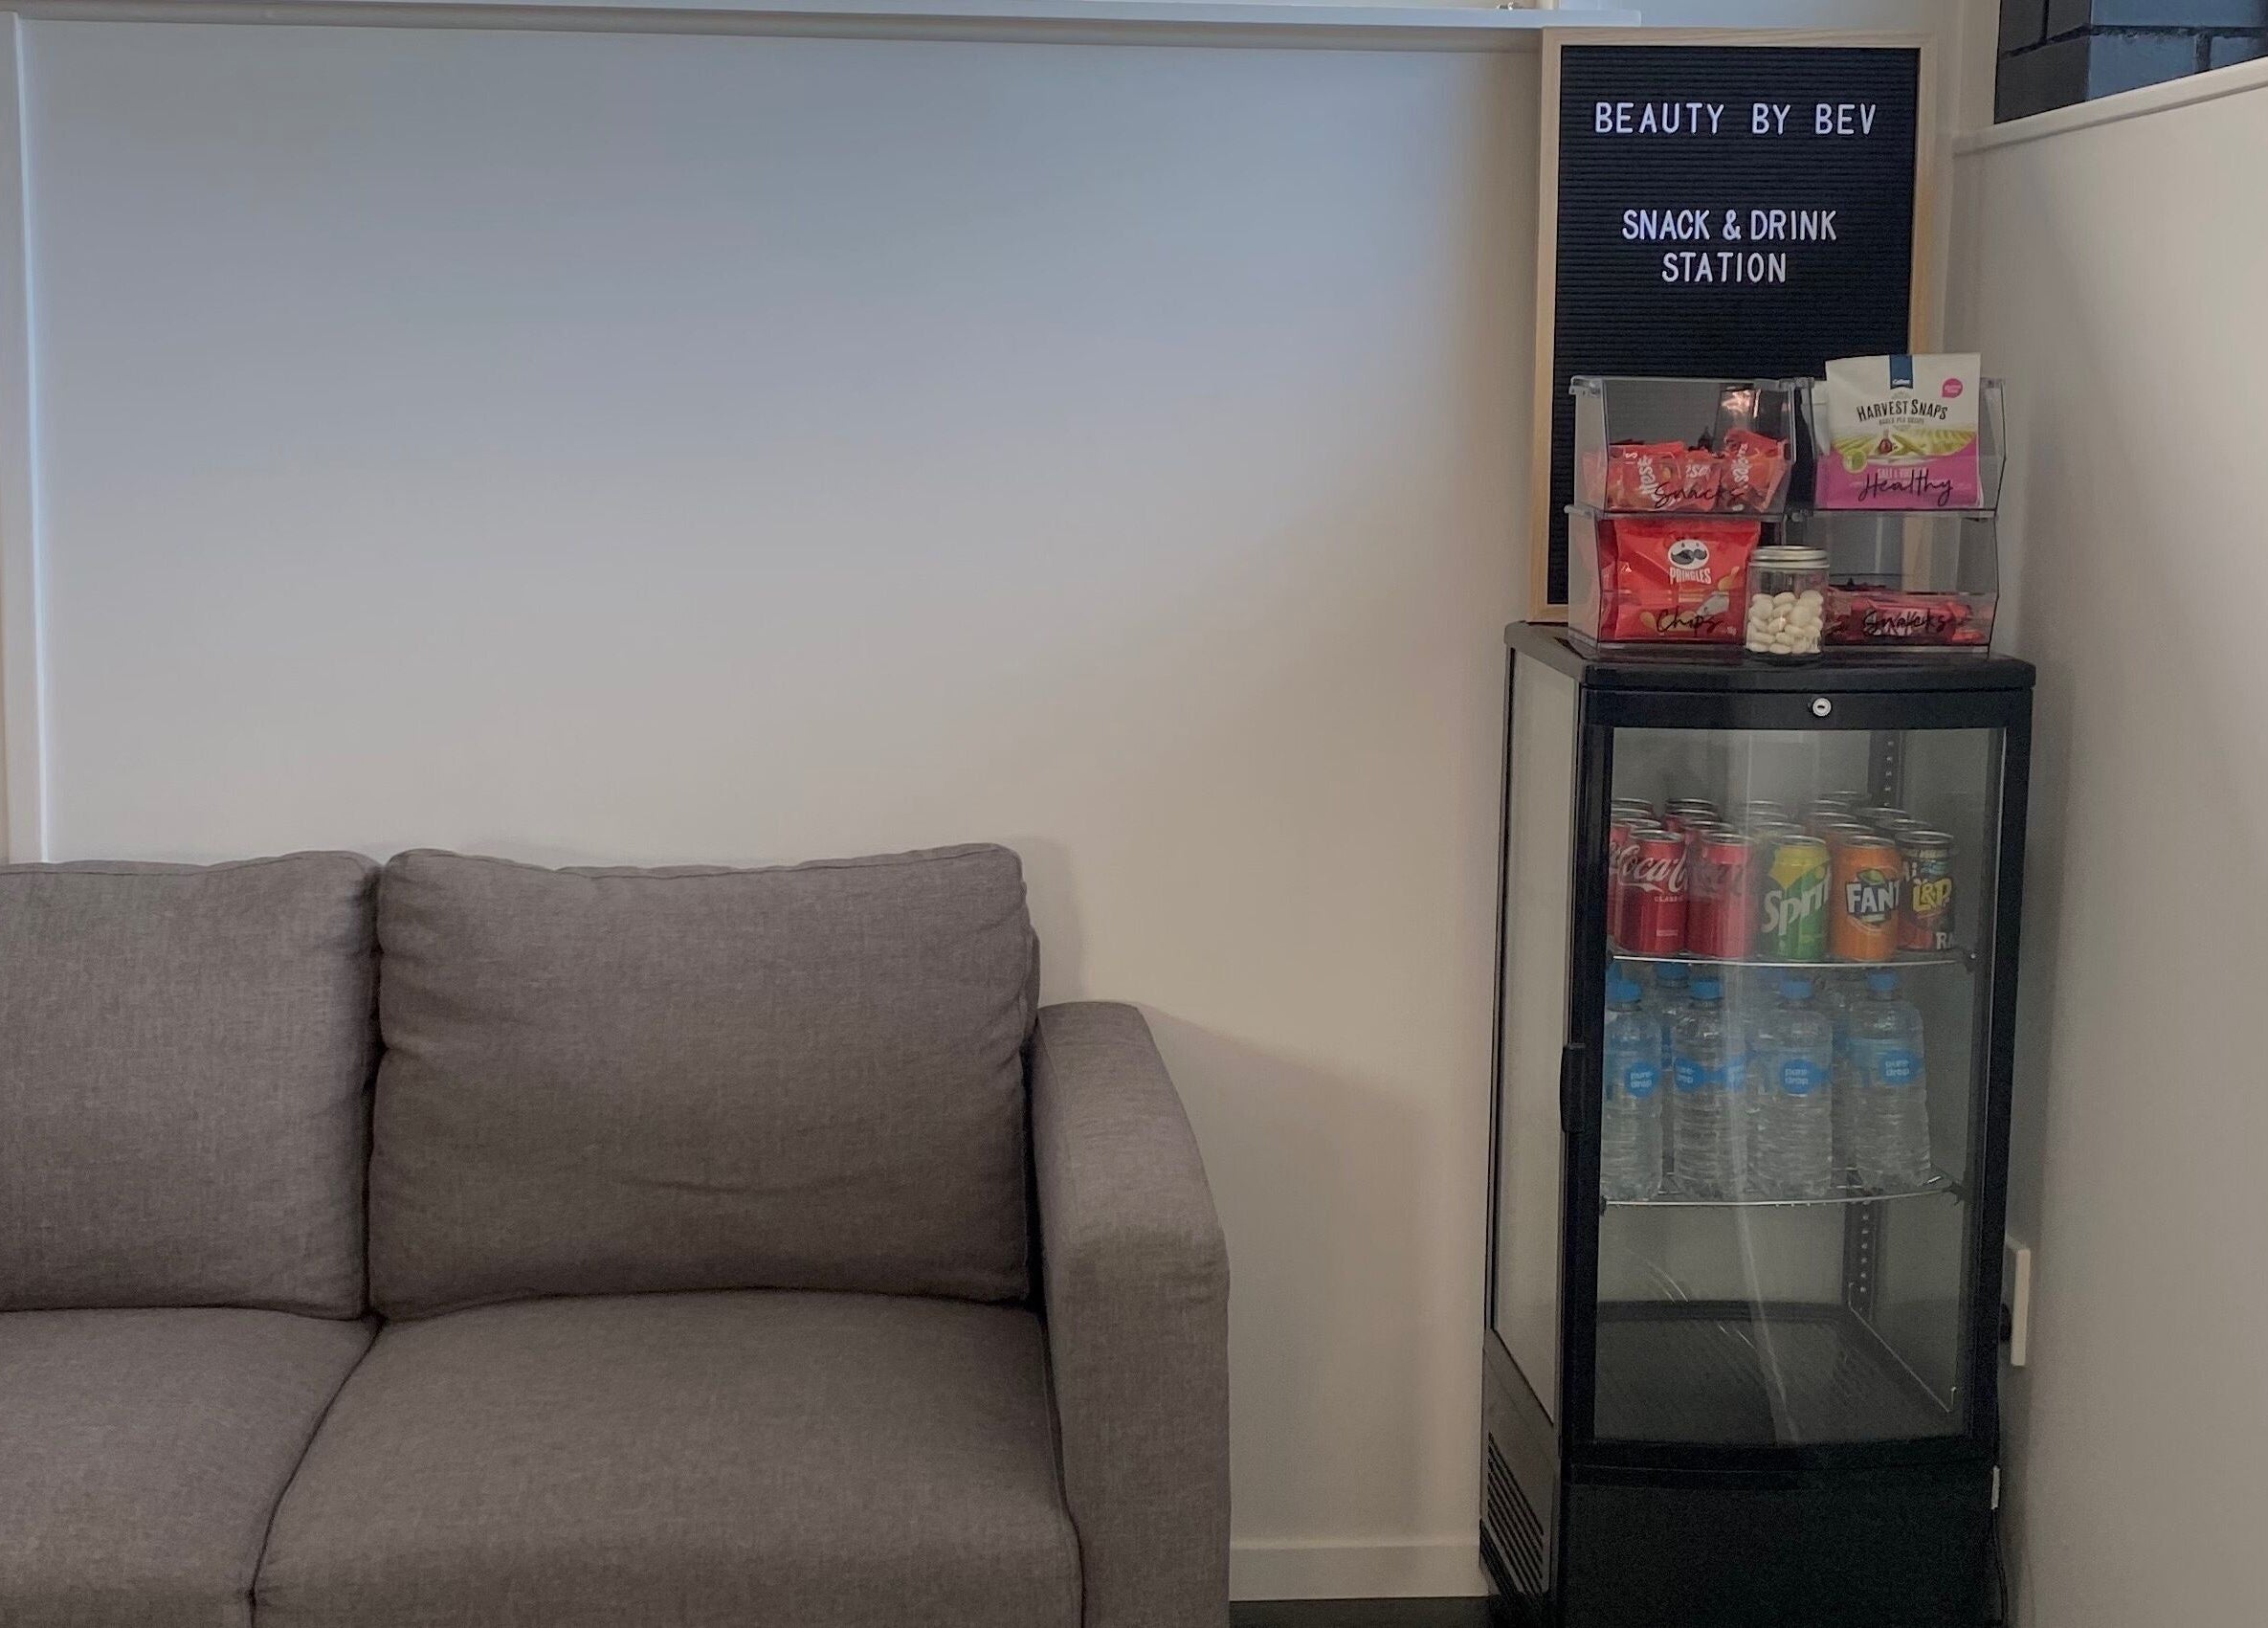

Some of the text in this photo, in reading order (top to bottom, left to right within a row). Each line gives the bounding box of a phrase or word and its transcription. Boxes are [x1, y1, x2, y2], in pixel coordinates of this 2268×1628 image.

[1596, 102, 1876, 134] BEAUTY BY BEV
[1623, 210, 1836, 240] SNACK & DRINK
[1662, 252, 1785, 282] STATION
[1857, 399, 1948, 422] HARVEST SNAPS
[1858, 468, 1954, 507] Healthy
[1669, 566, 1712, 586] PRINGLES
[1656, 605, 1723, 637] Chips
